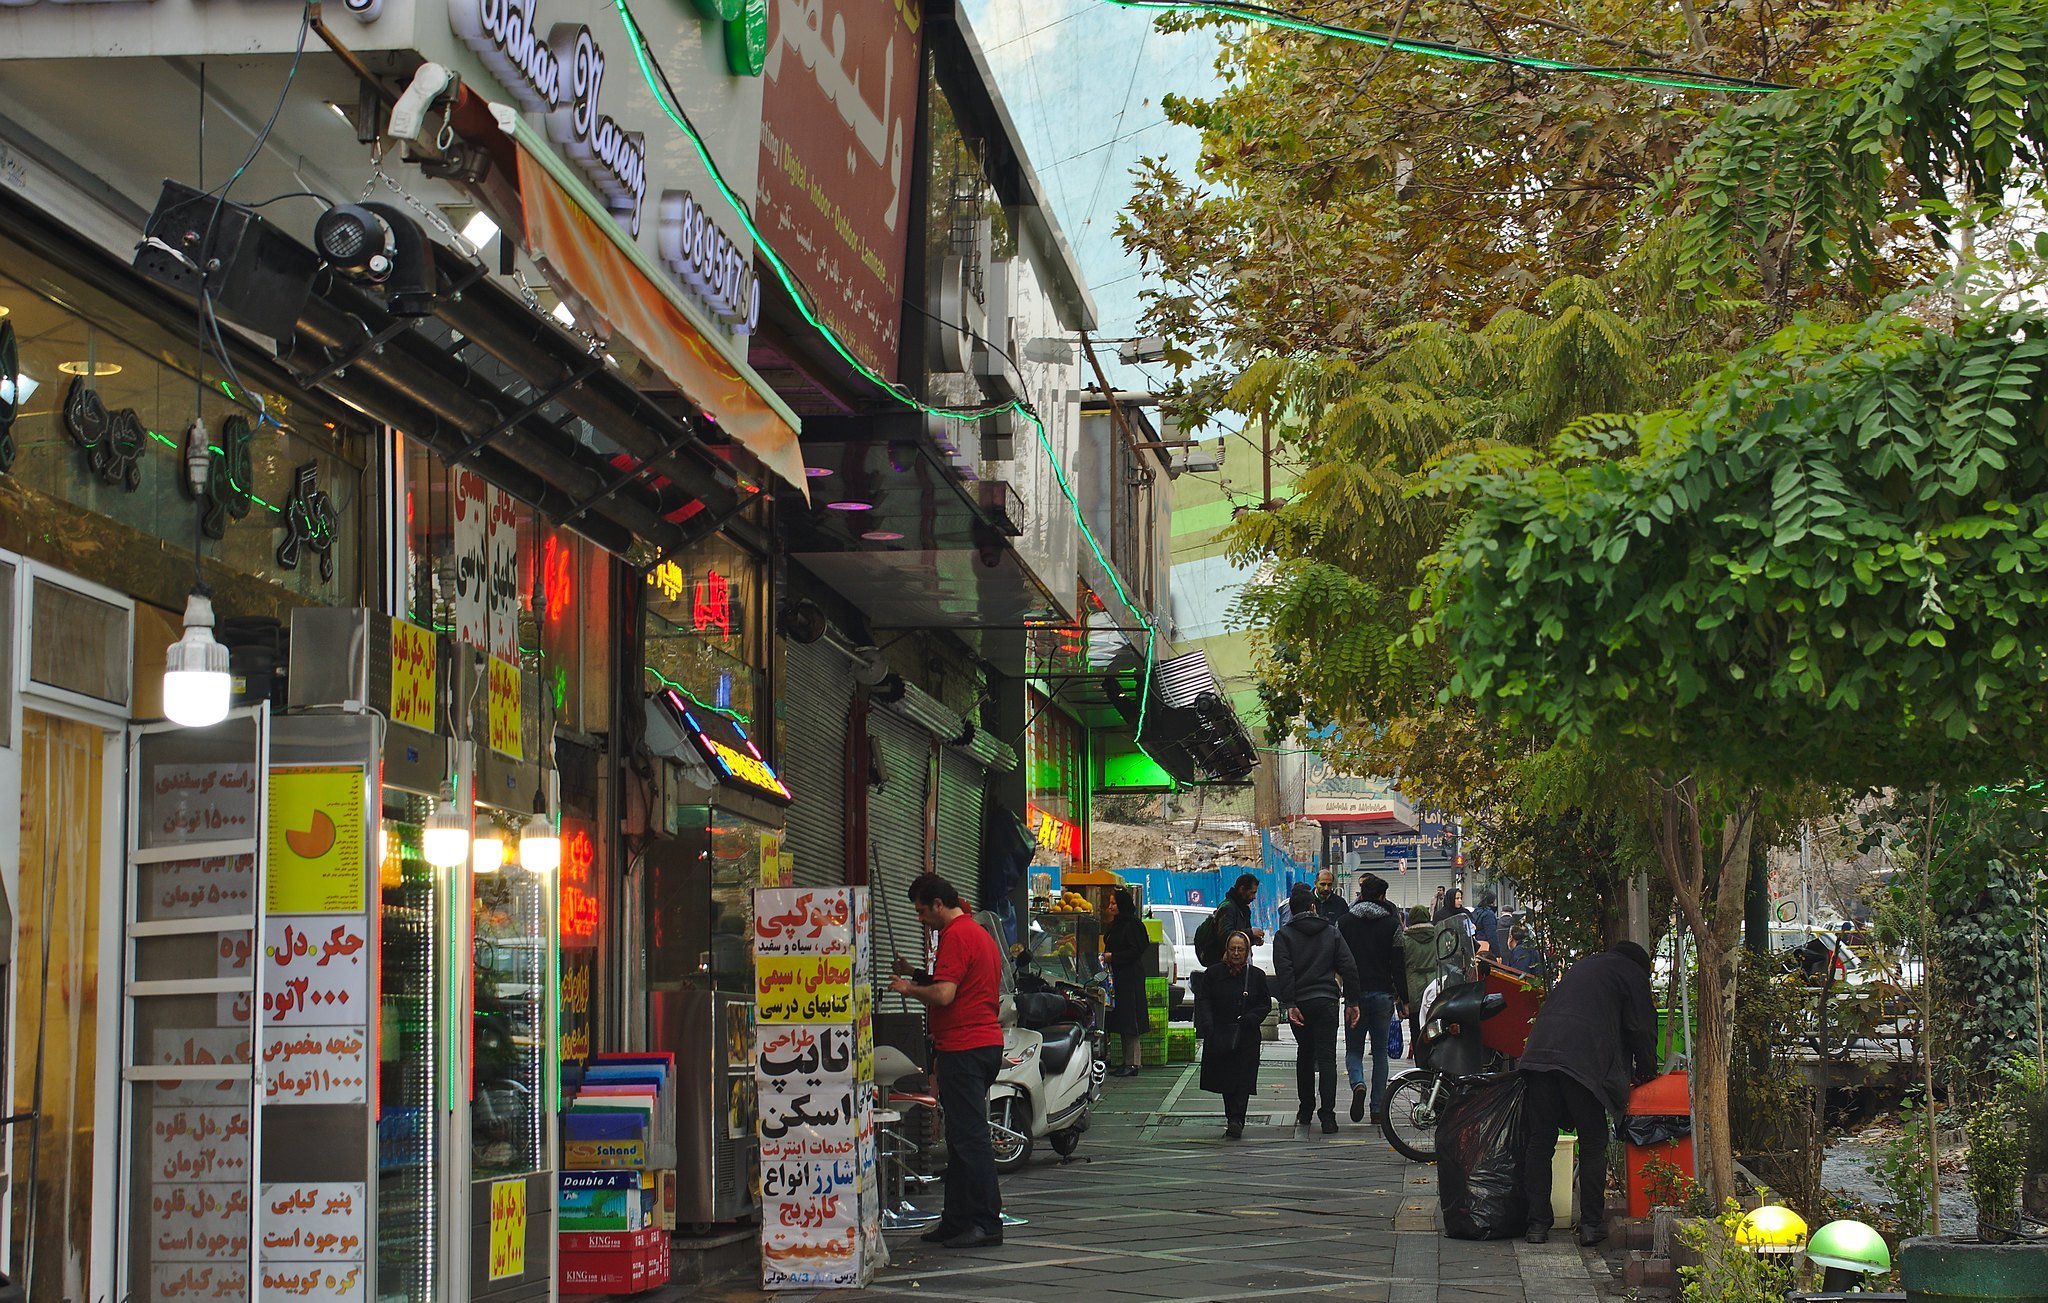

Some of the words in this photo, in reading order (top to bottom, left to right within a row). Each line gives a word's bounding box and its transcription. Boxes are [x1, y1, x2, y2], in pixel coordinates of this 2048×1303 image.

[572, 26, 645, 239] Narenj
[784, 142, 807, 192] Digital
[810, 173, 832, 220] Indoor
[835, 204, 859, 253] Outdoor
[861, 236, 887, 285] Laminate
[681, 194, 760, 333] 88951790
[163, 810, 201, 834] تومان
[204, 808, 246, 830] ۱۵۰۰۰
[161, 885, 205, 908] تومان
[207, 883, 248, 904] ۵۰۰۰
[755, 889, 849, 941] فتوکپی
[274, 924, 308, 966] دل
[317, 924, 364, 966] جگر
[758, 940, 781, 955] سفید
[783, 943, 789, 955] و
[791, 939, 812, 955] سیاه
[759, 969, 793, 994] سیمی
[805, 957, 850, 994] صحافی
[760, 997, 799, 1020] درسی
[802, 993, 850, 1020] کتابهای
[263, 1033, 323, 1063] مخصوص
[763, 1028, 815, 1053] طراحی
[760, 1027, 850, 1094] تایپ
[156, 1112, 187, 1142] قلوه
[193, 1113, 216, 1141] دل
[761, 1093, 851, 1139] اسکن
[597, 1145, 637, 1156] Sahand
[762, 1139, 806, 1161] اینترنت
[809, 1139, 854, 1156] خدمات
[564, 1177, 604, 1186] Double
[607, 1177, 616, 1186] A
[763, 1161, 810, 1197] انواع
[812, 1161, 854, 1195] شارژ
[153, 1188, 186, 1219] قلوه
[191, 1188, 216, 1218] دل
[271, 1188, 318, 1215] کبابی
[322, 1191, 352, 1216] پنیر
[779, 1194, 839, 1228] کارتریج
[159, 1227, 193, 1251] است
[197, 1232, 247, 1257] موجود
[263, 1227, 301, 1248] است
[304, 1231, 359, 1254] موجود
[589, 1235, 611, 1246] KING
[764, 1226, 856, 1261] لمینت
[160, 1267, 213, 1298] کبابی
[212, 1270, 246, 1298] پنیر
[262, 1269, 322, 1296] کوبیده
[325, 1268, 359, 1296] کره
[566, 1270, 588, 1281] KING
[765, 1271, 788, 1285] طولی
